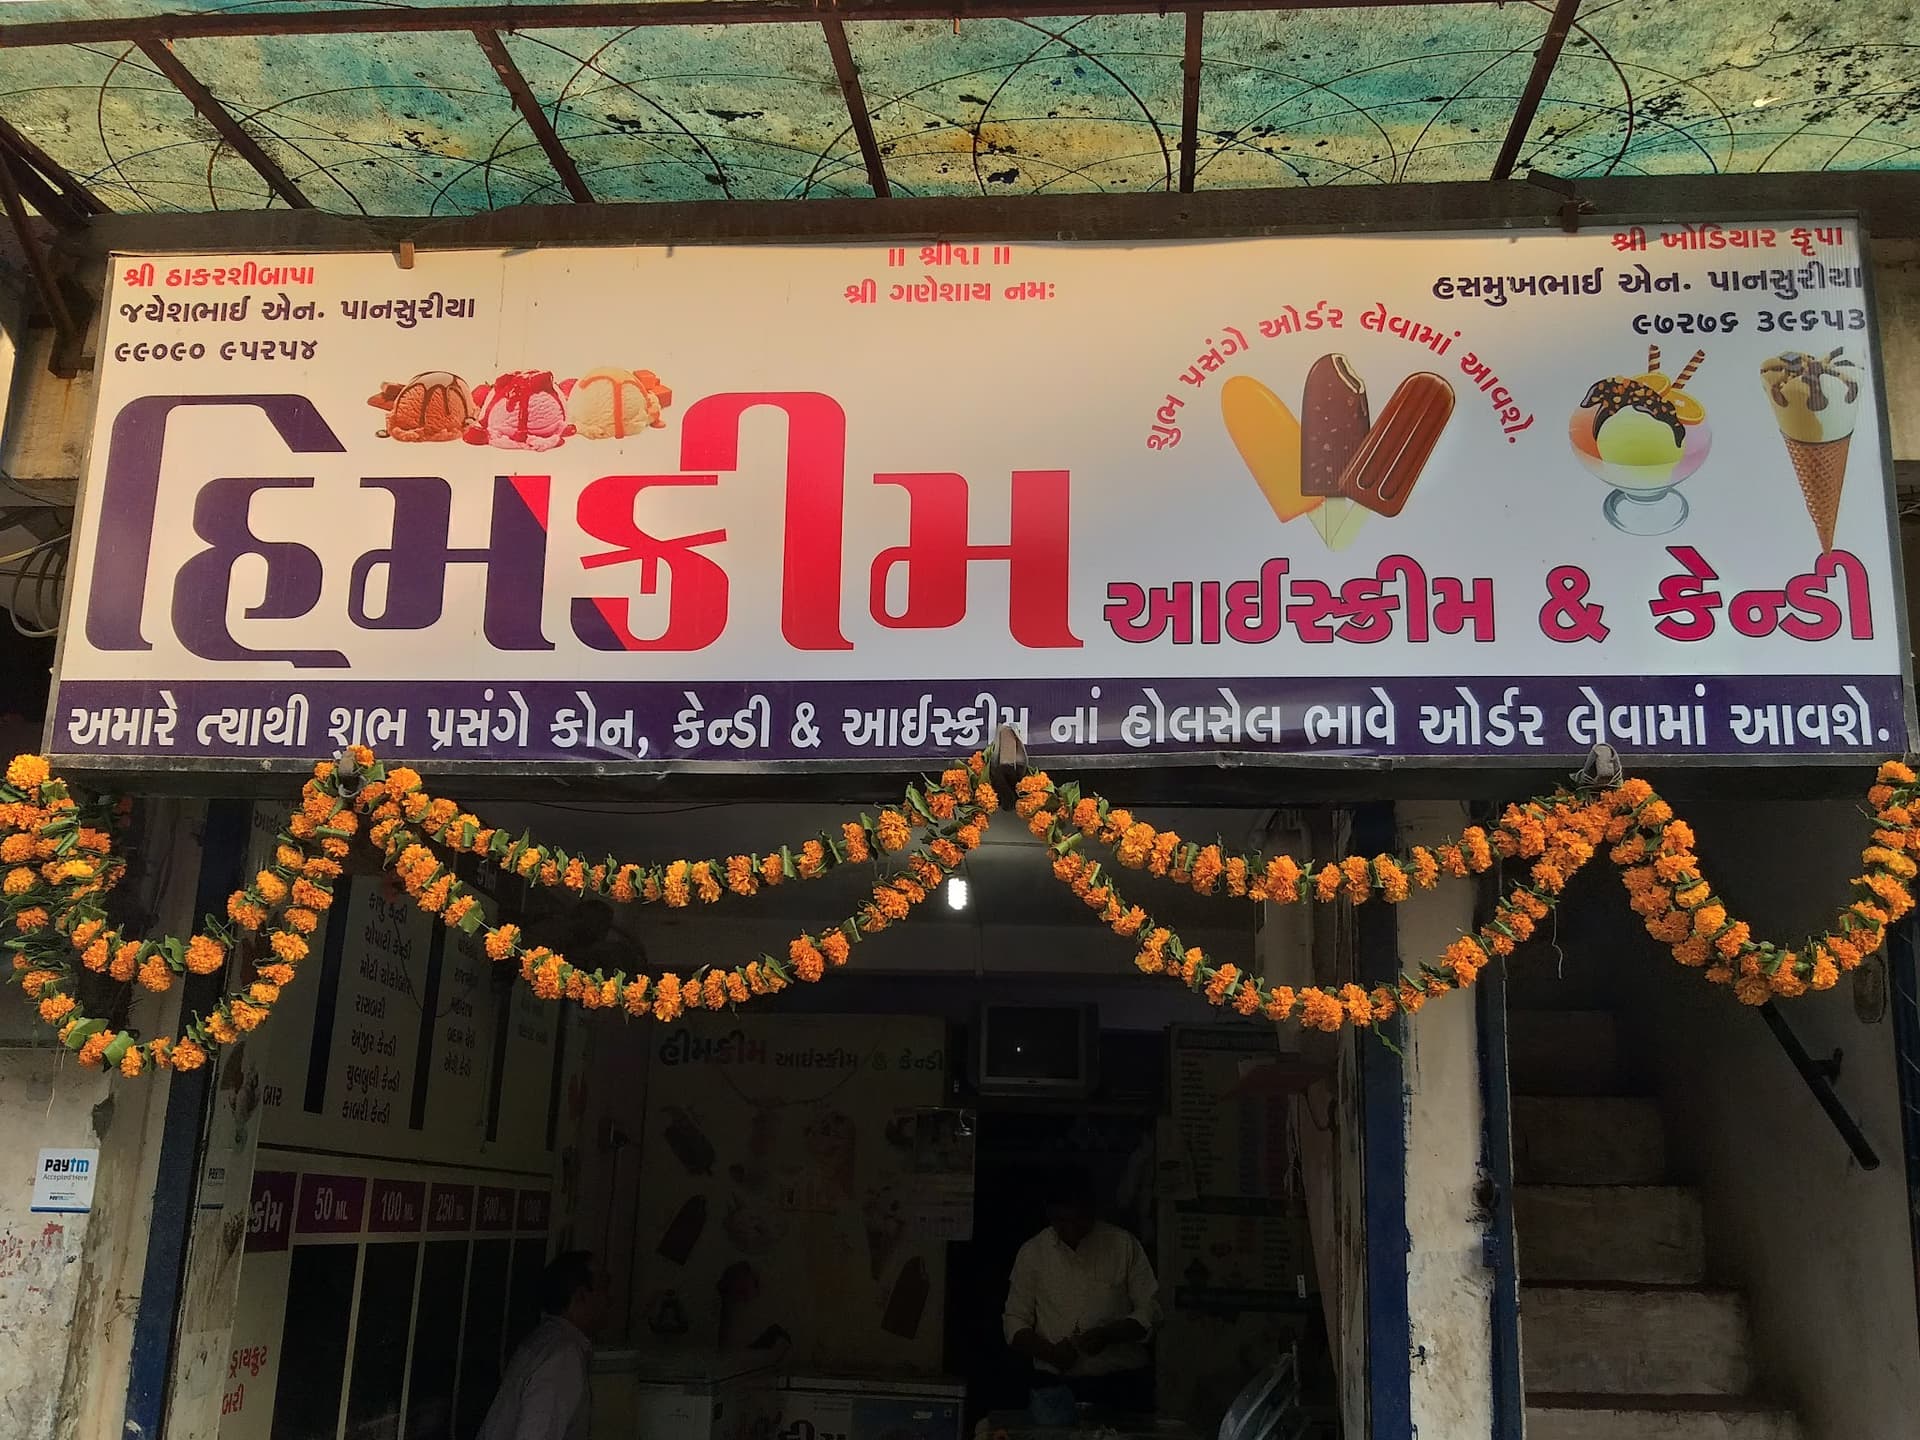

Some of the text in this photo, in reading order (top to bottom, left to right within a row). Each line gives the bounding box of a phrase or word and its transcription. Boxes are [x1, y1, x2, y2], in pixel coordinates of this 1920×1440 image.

[1610, 223, 1842, 257] શ્રી ખોડિયાર કૃપા
[123, 261, 315, 287] શ્રી ઠાકરશીબાપા
[843, 278, 877, 304] શ્રી
[888, 275, 991, 303] ગણેશાય
[1431, 260, 1863, 307] હસમુખભાઈ એન. પાનસુરીયા
[119, 291, 476, 328] જયેશભાઈ એન. પાનસુરીયા
[1631, 308, 1867, 336] ૯૭૨૭૬ ૩૯૬૫૩
[113, 341, 206, 363] ૯૯૦૯૦
[1146, 393, 1185, 451] શુભ
[1178, 326, 1250, 389] પ્રસંગે
[1258, 299, 1344, 339] ઓર્ડર
[1359, 301, 1463, 357] લેવામાં
[84, 390, 1085, 670] હિમક્રીમ
[1102, 545, 1875, 645] આઈસ્ક્રીમ & કેન્ડી
[67, 690, 178, 747] અમારે
[195, 691, 309, 747] ત્યાથી
[427, 689, 530, 752] પ્રસંગે
[549, 691, 650, 757] કોન,
[672, 692, 771, 749] કેન્ડી
[790, 701, 821, 749] &
[1050, 686, 1101, 747] નાં
[1121, 687, 1282, 748] હોલસેલ
[1303, 686, 1396, 747] ભાવે
[1418, 686, 1543, 747] ઓર્ડર
[1567, 683, 1707, 747] લેવામાં
[1729, 685, 1891, 747] આવશે.
[313, 1187, 334, 1221] 50
[381, 1191, 403, 1222] 100
